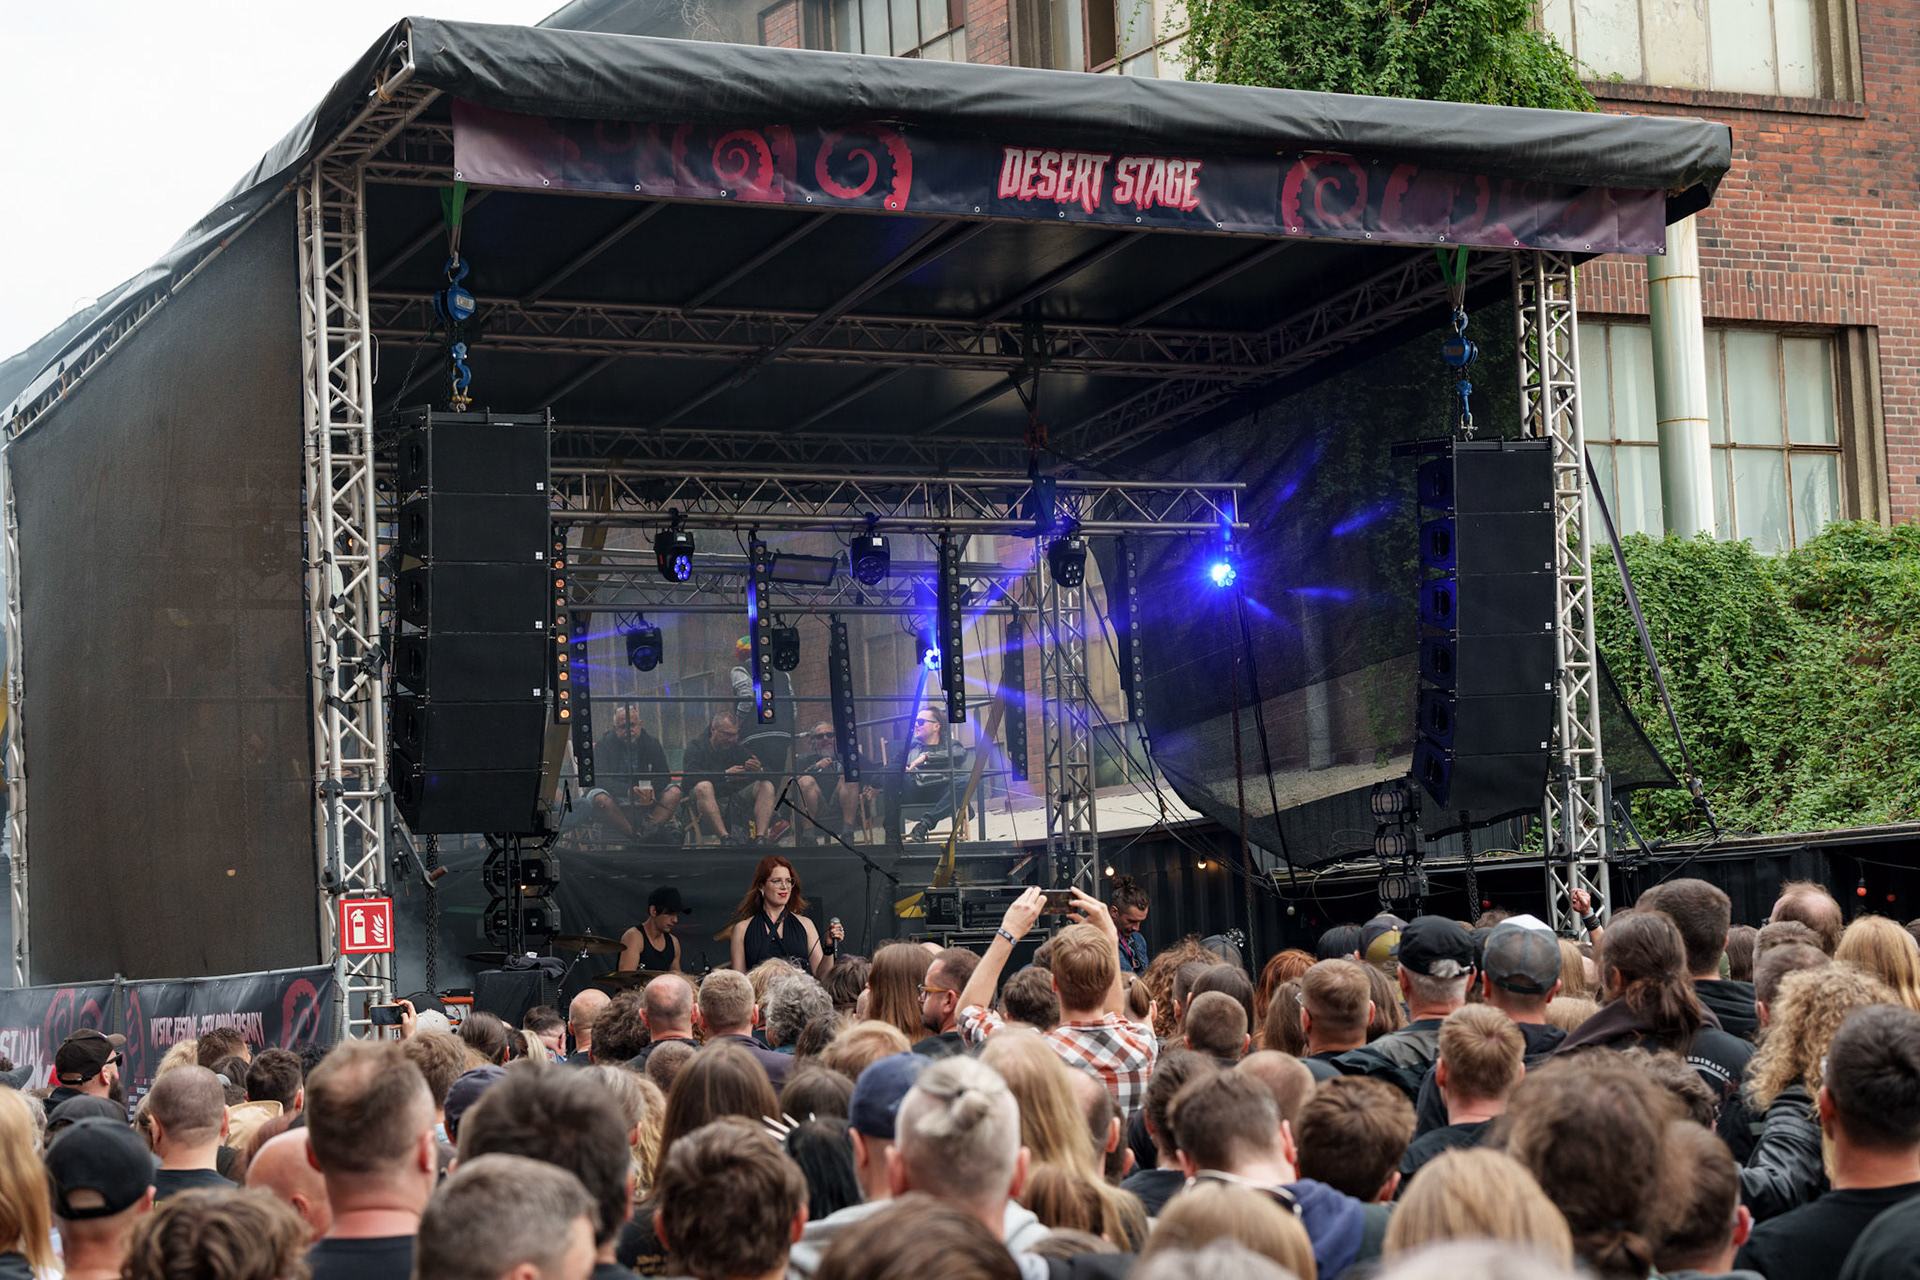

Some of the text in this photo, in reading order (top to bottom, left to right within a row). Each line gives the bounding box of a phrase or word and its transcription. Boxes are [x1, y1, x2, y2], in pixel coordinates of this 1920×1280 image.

[998, 147, 1202, 213] DESERT STAGE
[150, 1016, 173, 1050] MYSTIC
